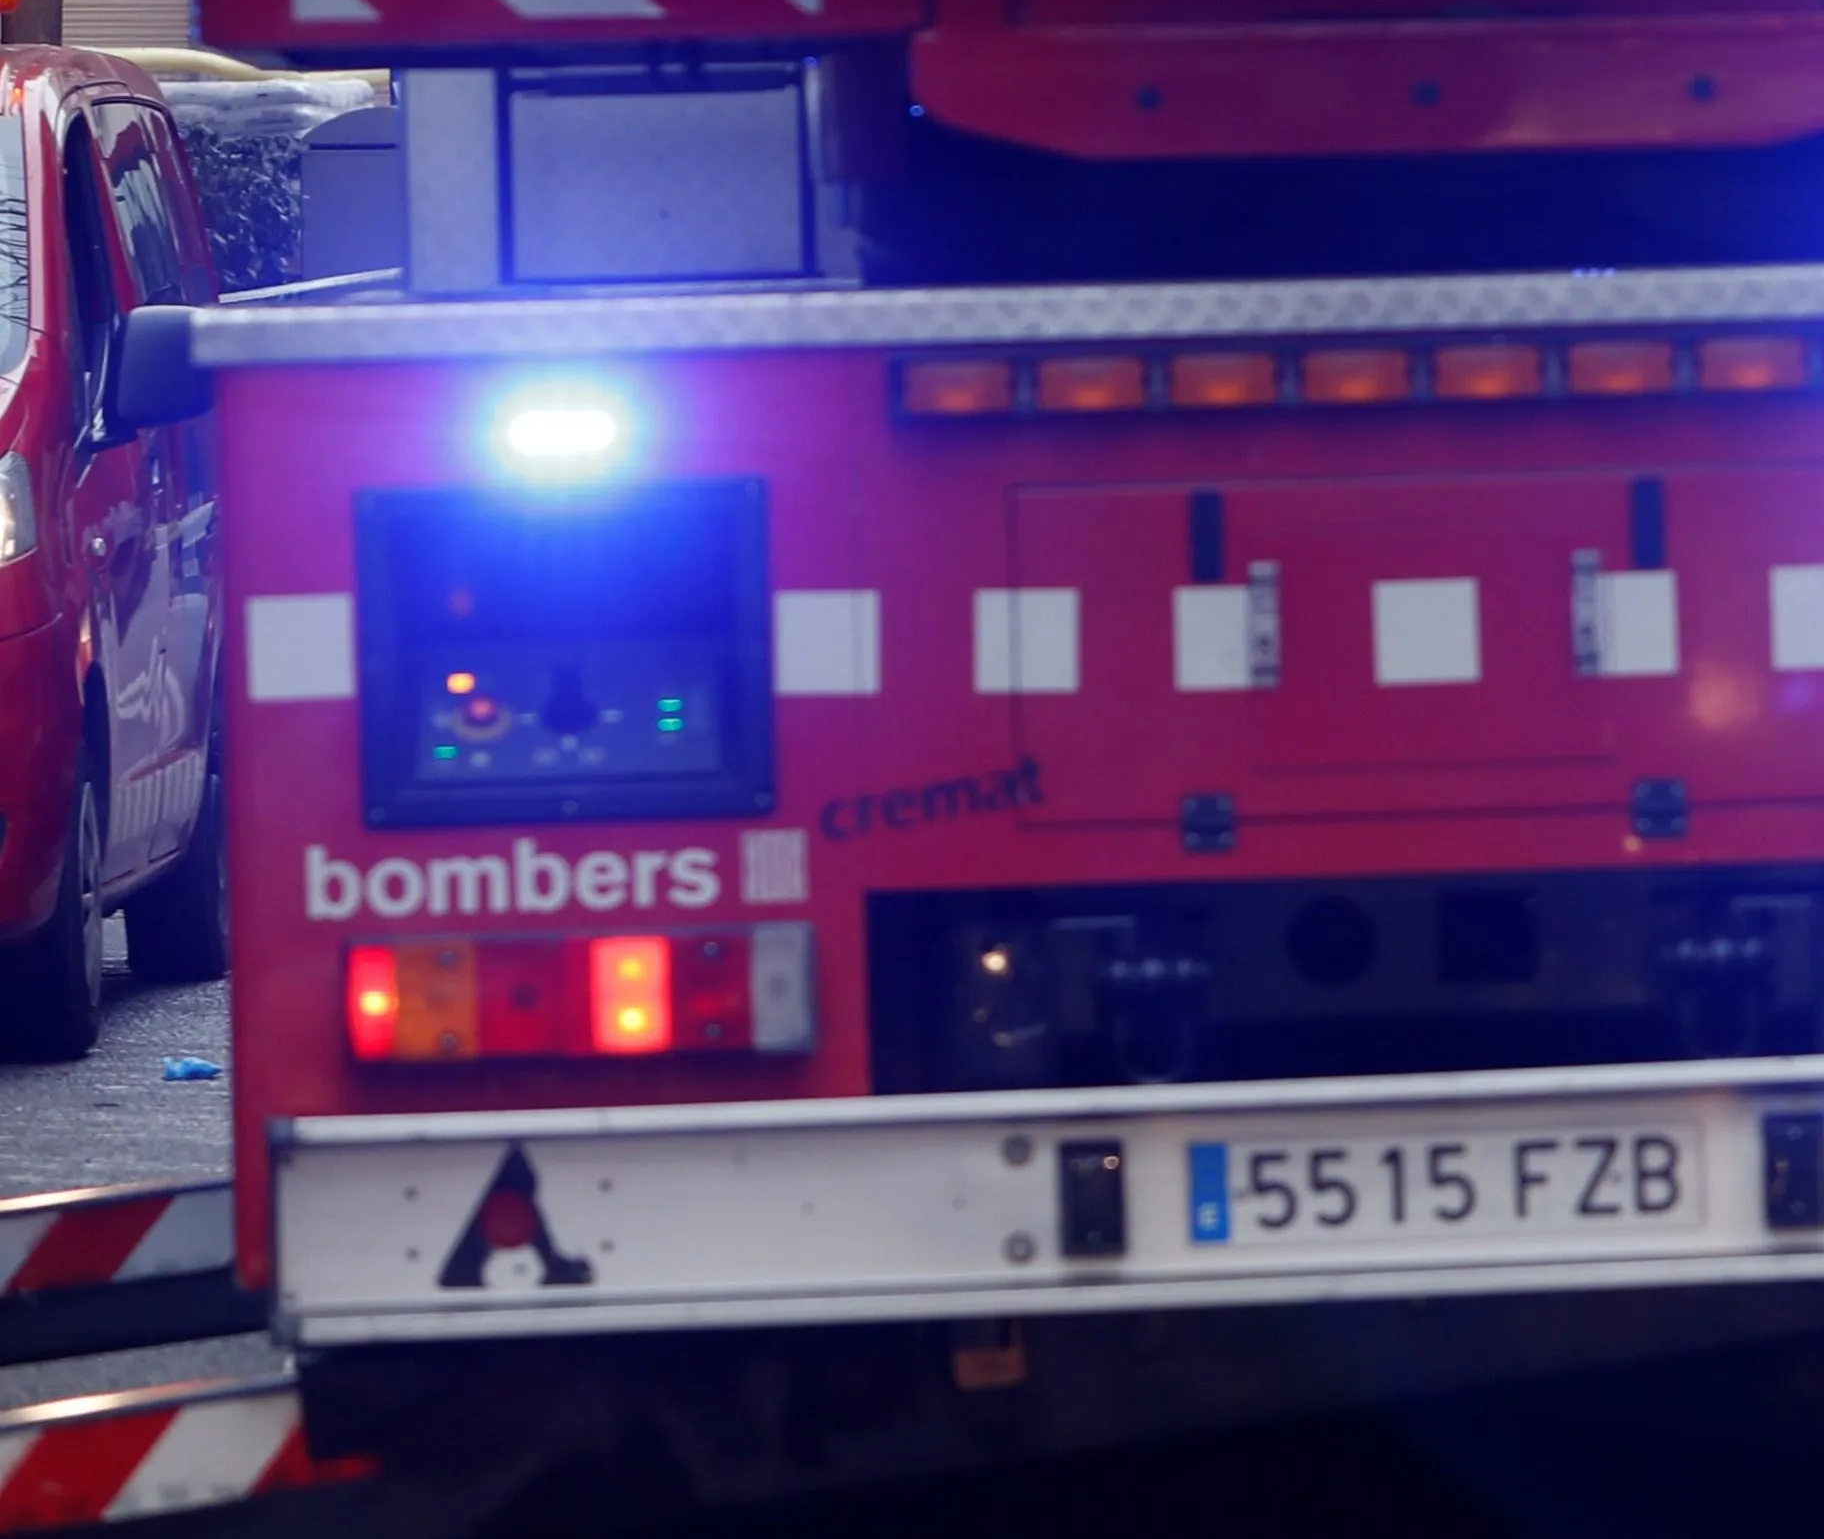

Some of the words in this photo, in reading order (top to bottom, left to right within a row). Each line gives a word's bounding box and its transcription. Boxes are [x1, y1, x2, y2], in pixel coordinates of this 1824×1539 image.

[819, 753, 1044, 842] cremat
[304, 837, 721, 920] bombers
[1248, 1142, 1479, 1230] 5515
[1513, 1134, 1682, 1218] FZB
